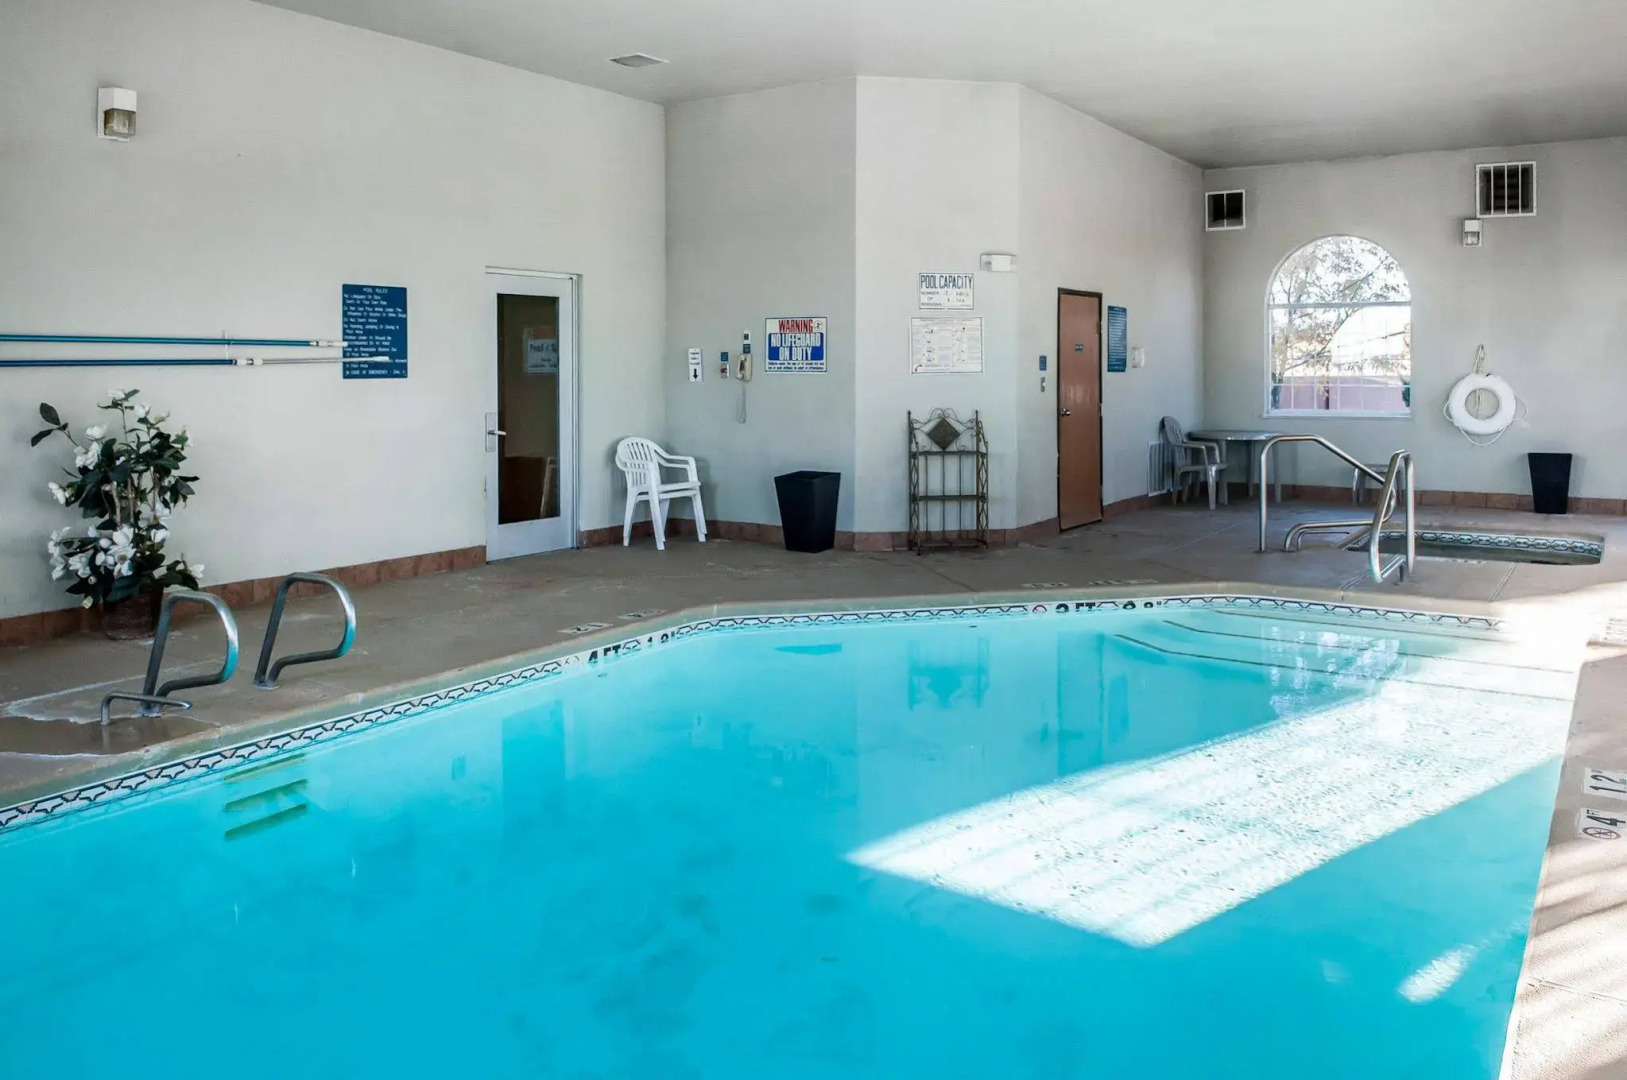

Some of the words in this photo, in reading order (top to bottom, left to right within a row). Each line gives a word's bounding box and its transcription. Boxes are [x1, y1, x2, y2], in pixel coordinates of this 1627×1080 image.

[921, 275, 937, 288] POOL
[939, 275, 972, 289] CAPACITY
[778, 319, 813, 333] WARNING
[771, 333, 781, 347] NO
[782, 333, 821, 347] LIFEGUARD
[779, 347, 789, 360] ON
[792, 347, 812, 360] DUTY
[604, 644, 621, 656] FT
